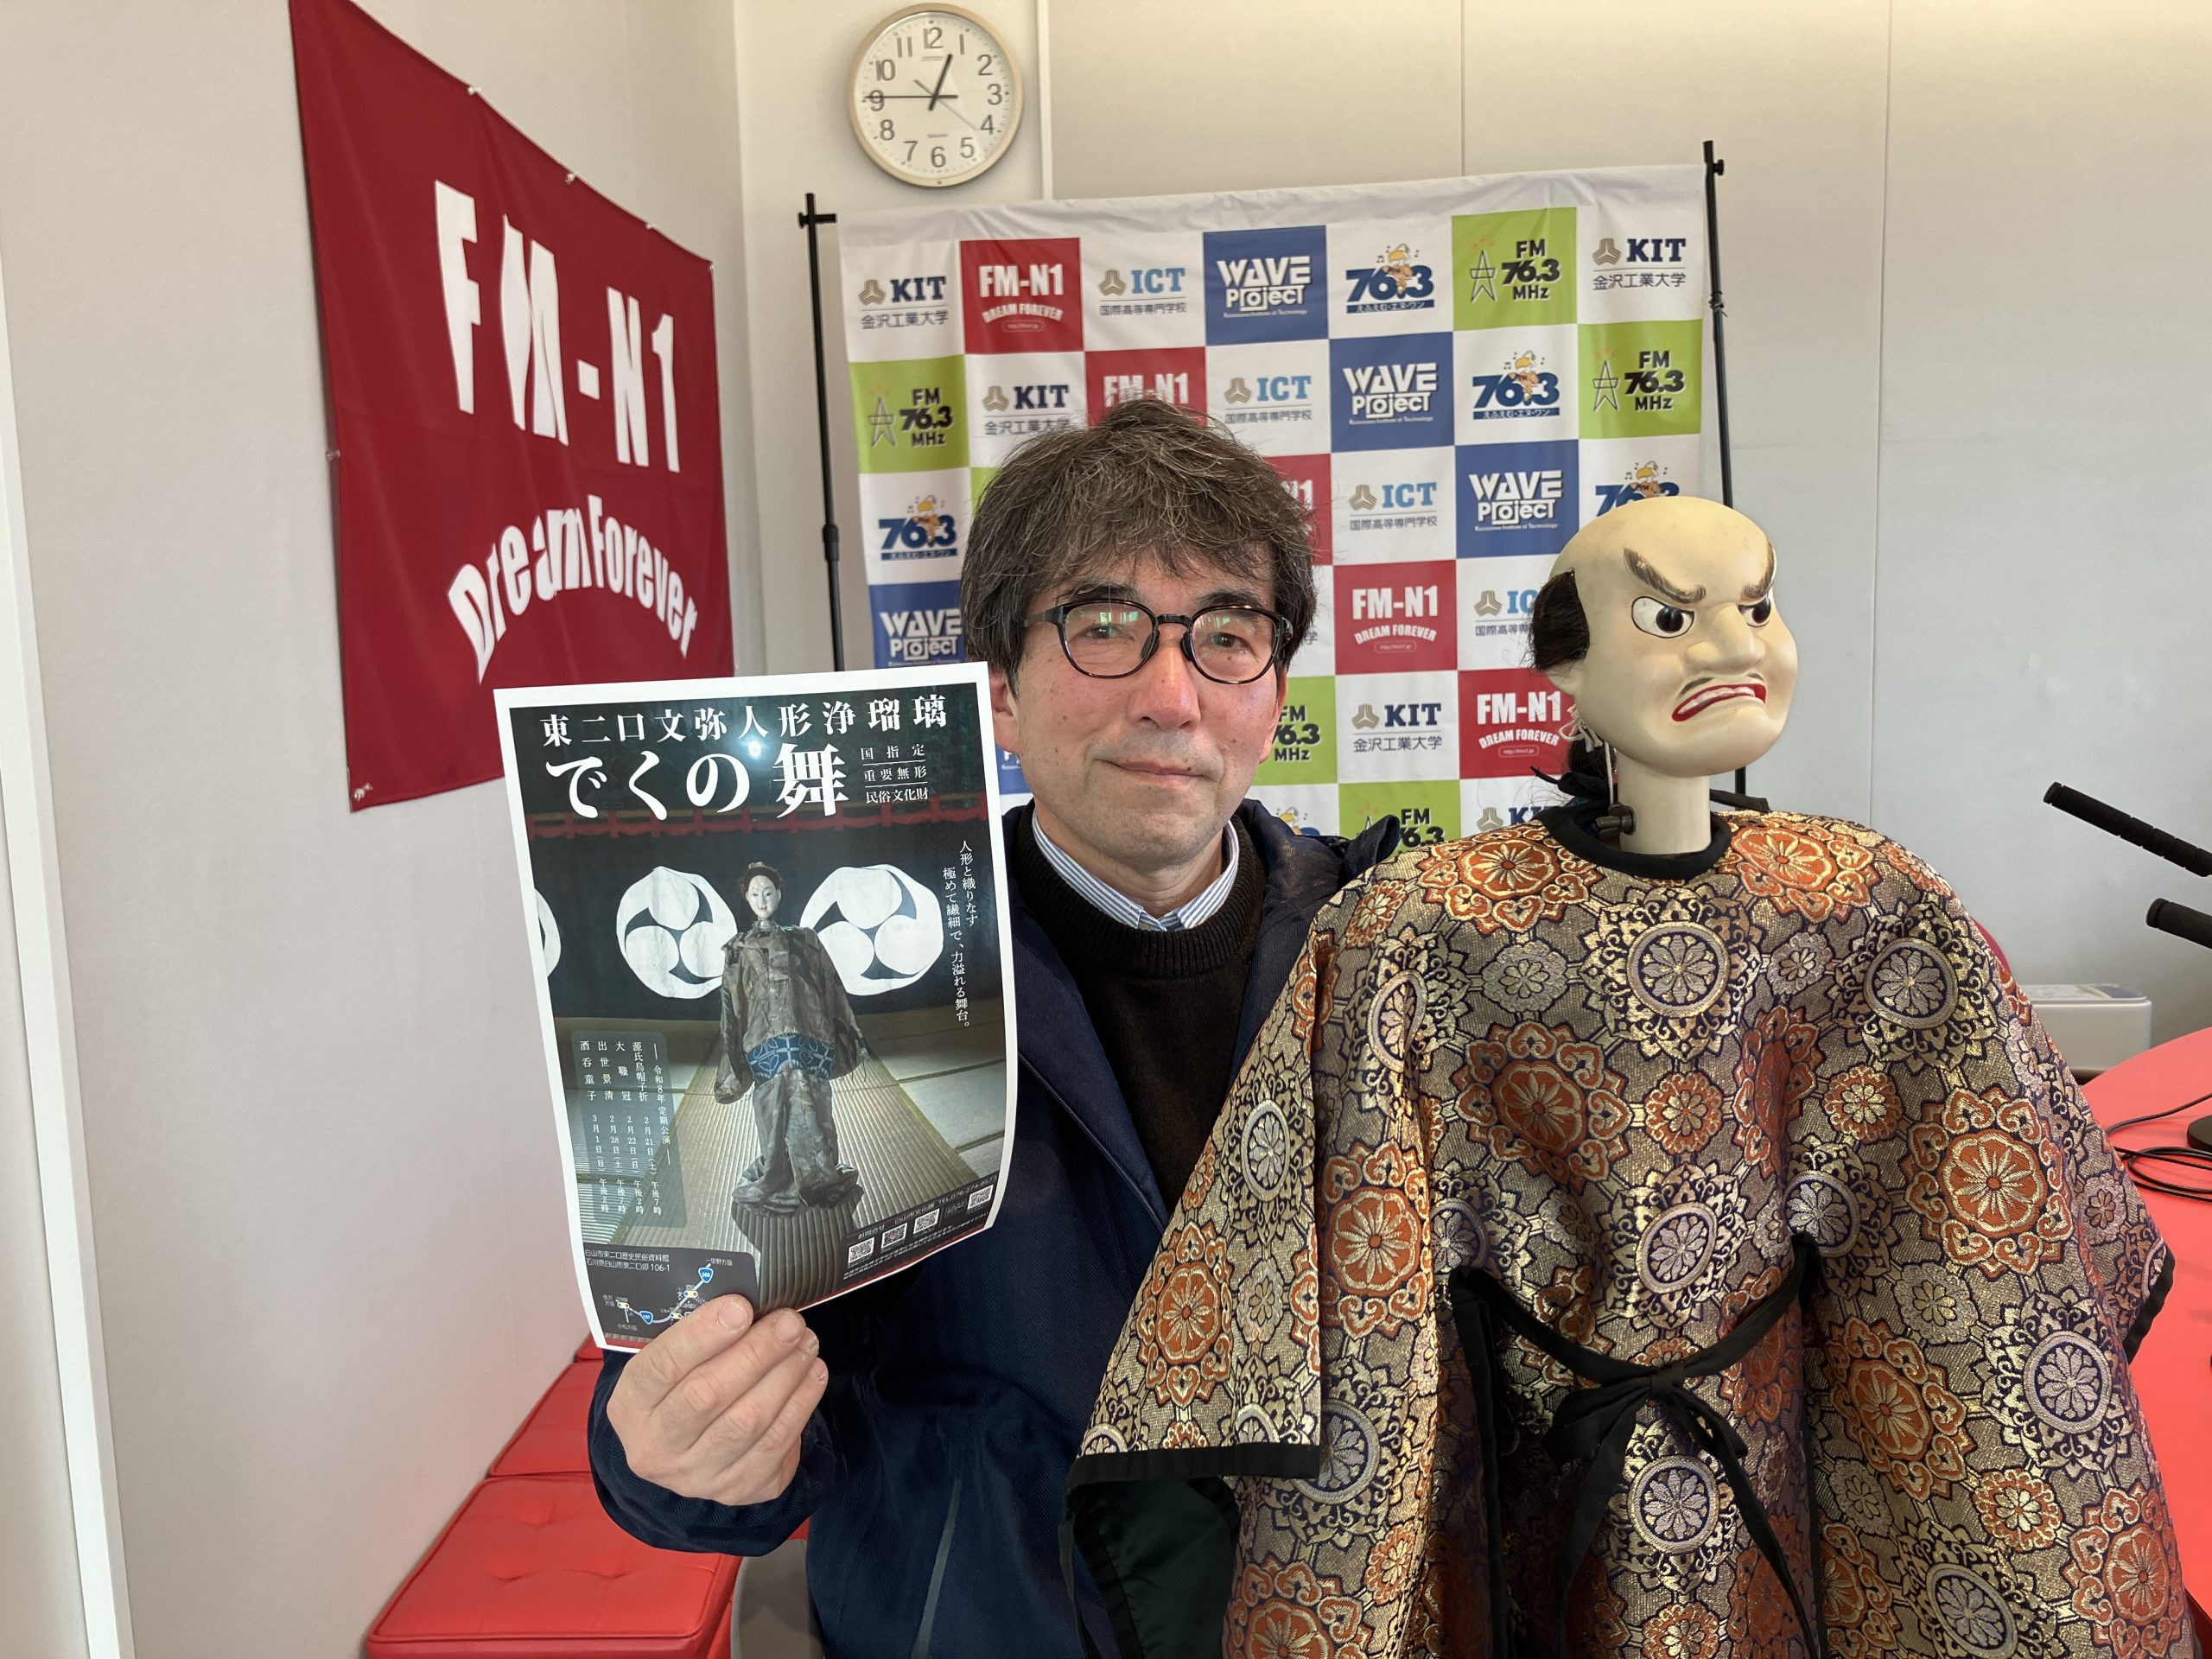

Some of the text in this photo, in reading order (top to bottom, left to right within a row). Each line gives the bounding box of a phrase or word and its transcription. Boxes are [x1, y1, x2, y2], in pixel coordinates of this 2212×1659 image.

[897, 36, 913, 58] 11
[923, 27, 944, 49] 12
[958, 34, 965, 55] 1
[874, 59, 896, 81] 10
[976, 54, 993, 76] 2
[868, 89, 885, 111] 9
[987, 84, 1003, 105] 3
[880, 119, 895, 141] 8
[980, 114, 995, 135] 4
[903, 140, 918, 162] 7
[930, 146, 947, 168] 6
[959, 137, 976, 158] 5
[1516, 239, 1546, 258] FM
[1626, 238, 1687, 262] KIT
[978, 264, 1064, 297] FM-N1
[1130, 268, 1185, 294] ICT
[1216, 256, 1311, 287] WAVE
[1502, 259, 1560, 284] 76.3
[1593, 272, 1687, 290] 金沢工業大学
[891, 276, 946, 302] KIT
[1345, 265, 1434, 302] 76.3
[1513, 285, 1549, 300] MHz
[861, 310, 949, 329] 金沢工業大学
[1099, 302, 1187, 316] 国際高等専門学校
[436, 179, 679, 473] FM-N1
[1639, 350, 1669, 369] FM
[1256, 375, 1312, 402] ICT
[1342, 362, 1438, 393] WAVE
[1624, 370, 1684, 394] 76.3
[912, 388, 941, 406] FM
[1014, 385, 1069, 410] KIT
[1472, 372, 1560, 408] 76.3
[1635, 396, 1673, 410] MHz
[899, 405, 954, 430] 76.3
[1224, 410, 1313, 424] 国際高等専門学校
[912, 432, 946, 447] MHz
[1382, 481, 1438, 508] ICT
[1469, 470, 1562, 501] WAVE
[878, 515, 957, 550] 76.3
[1350, 516, 1438, 531] 国際高等専門学校
[1351, 586, 1438, 620] FM-N1
[1507, 589, 1538, 614] IC
[880, 608, 963, 638] WAVE
[1475, 623, 1529, 637] 国際高等専
[1354, 624, 1437, 645] DREAM FOREVER
[1384, 702, 1441, 727] KIT
[1478, 691, 1561, 725] FM-N1
[540, 693, 947, 748] 東二口文弥人形浄瑠璃
[1353, 735, 1442, 752] 金沢工業大学
[1478, 728, 1560, 749] DREAM FOREVER
[861, 744, 925, 760] 国指定
[1274, 747, 1310, 761] MHz
[545, 742, 850, 821] でくの舞
[864, 766, 927, 782] 重要無形
[866, 787, 929, 804] 民俗文化財
[1401, 808, 1430, 824] FM
[1400, 825, 1445, 848] 6.3
[959, 840, 978, 926] 人形と織りなす
[580, 1040, 597, 1101] 酒呑童子
[600, 1178, 609, 1213] 午後2時
[598, 1040, 613, 1101] 出世景清
[616, 1179, 626, 1215] 午後7時
[633, 1179, 644, 1215] 午後2時
[651, 1180, 662, 1216] 午後7時
[651, 1263, 670, 1272] 106-1
